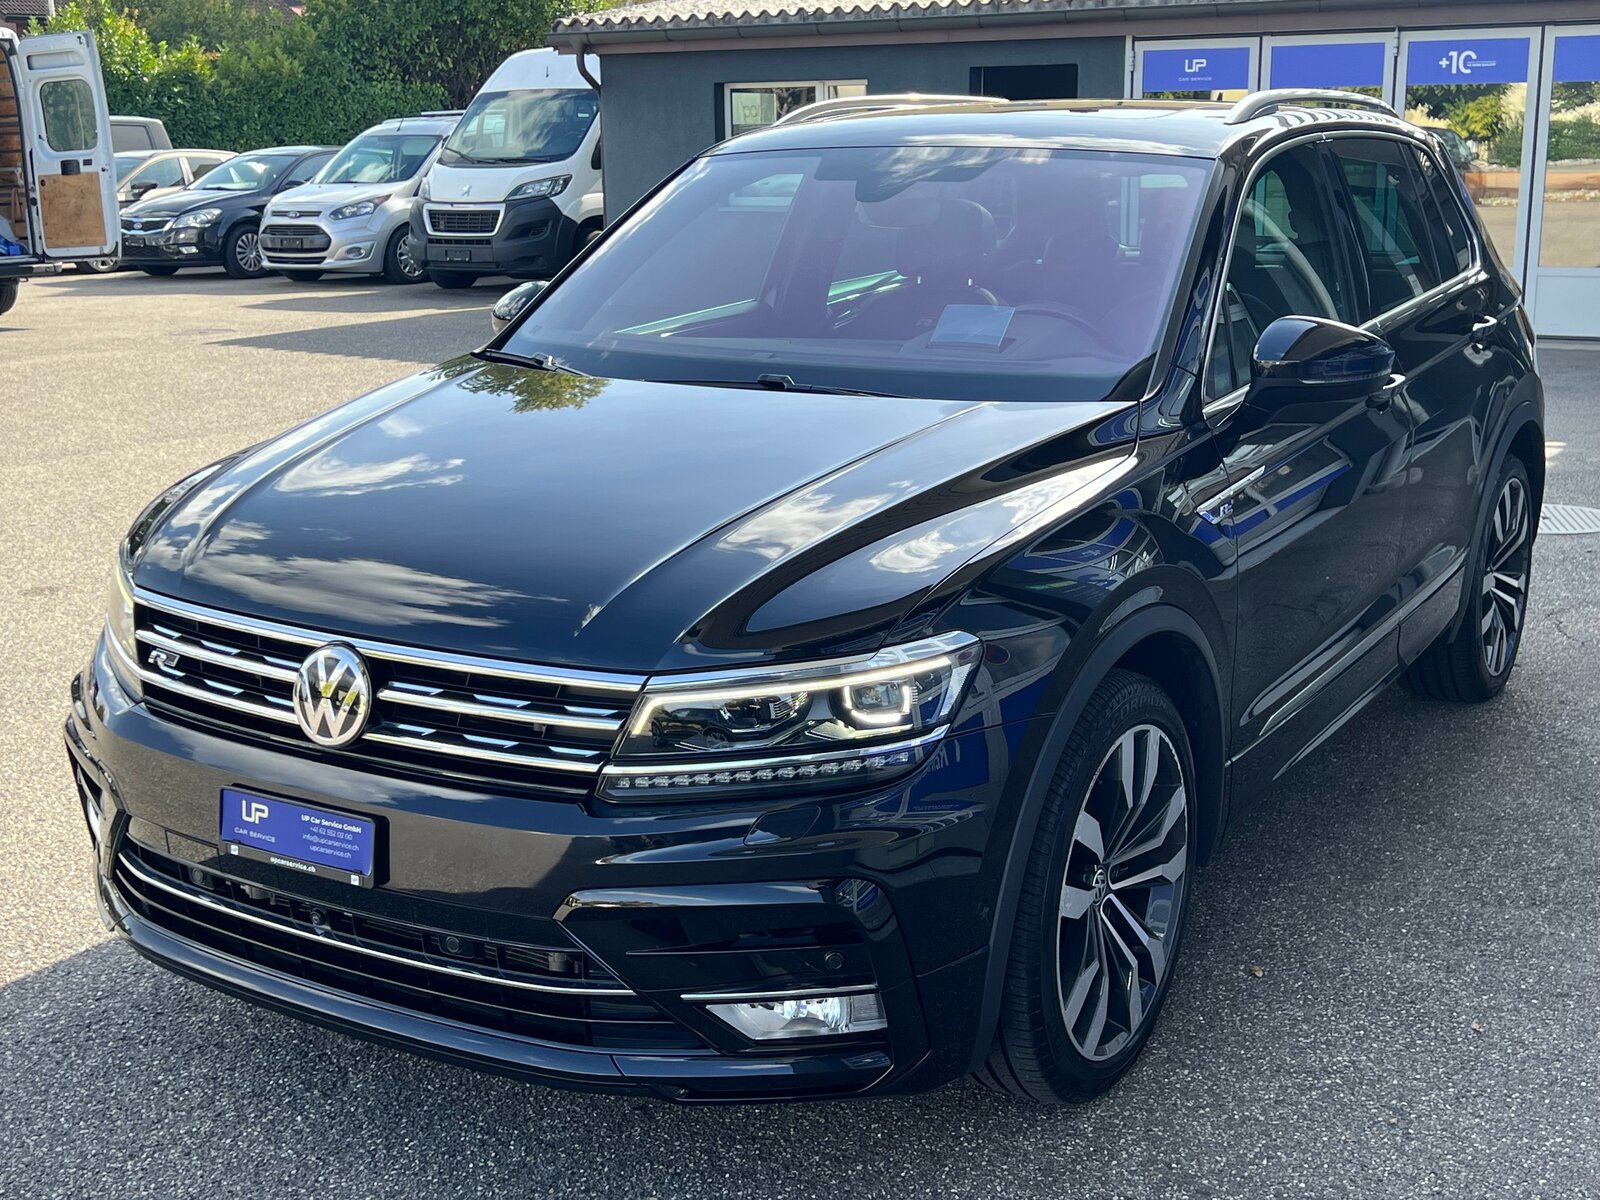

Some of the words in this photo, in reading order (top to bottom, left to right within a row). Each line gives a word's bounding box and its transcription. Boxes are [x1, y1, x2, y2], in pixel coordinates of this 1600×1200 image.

[1185, 59, 1207, 73] UP
[242, 799, 269, 824] UP
[301, 814, 310, 822] UP
[310, 816, 321, 825] Car
[321, 818, 343, 829] Service
[343, 823, 362, 834] GmbH
[233, 827, 248, 835] CAR
[249, 830, 276, 843] SERVICE
[302, 833, 360, 851] info@upcarservice.ch
[310, 845, 352, 859] upcarservice.ch
[270, 856, 317, 873] upcarservice.ch
